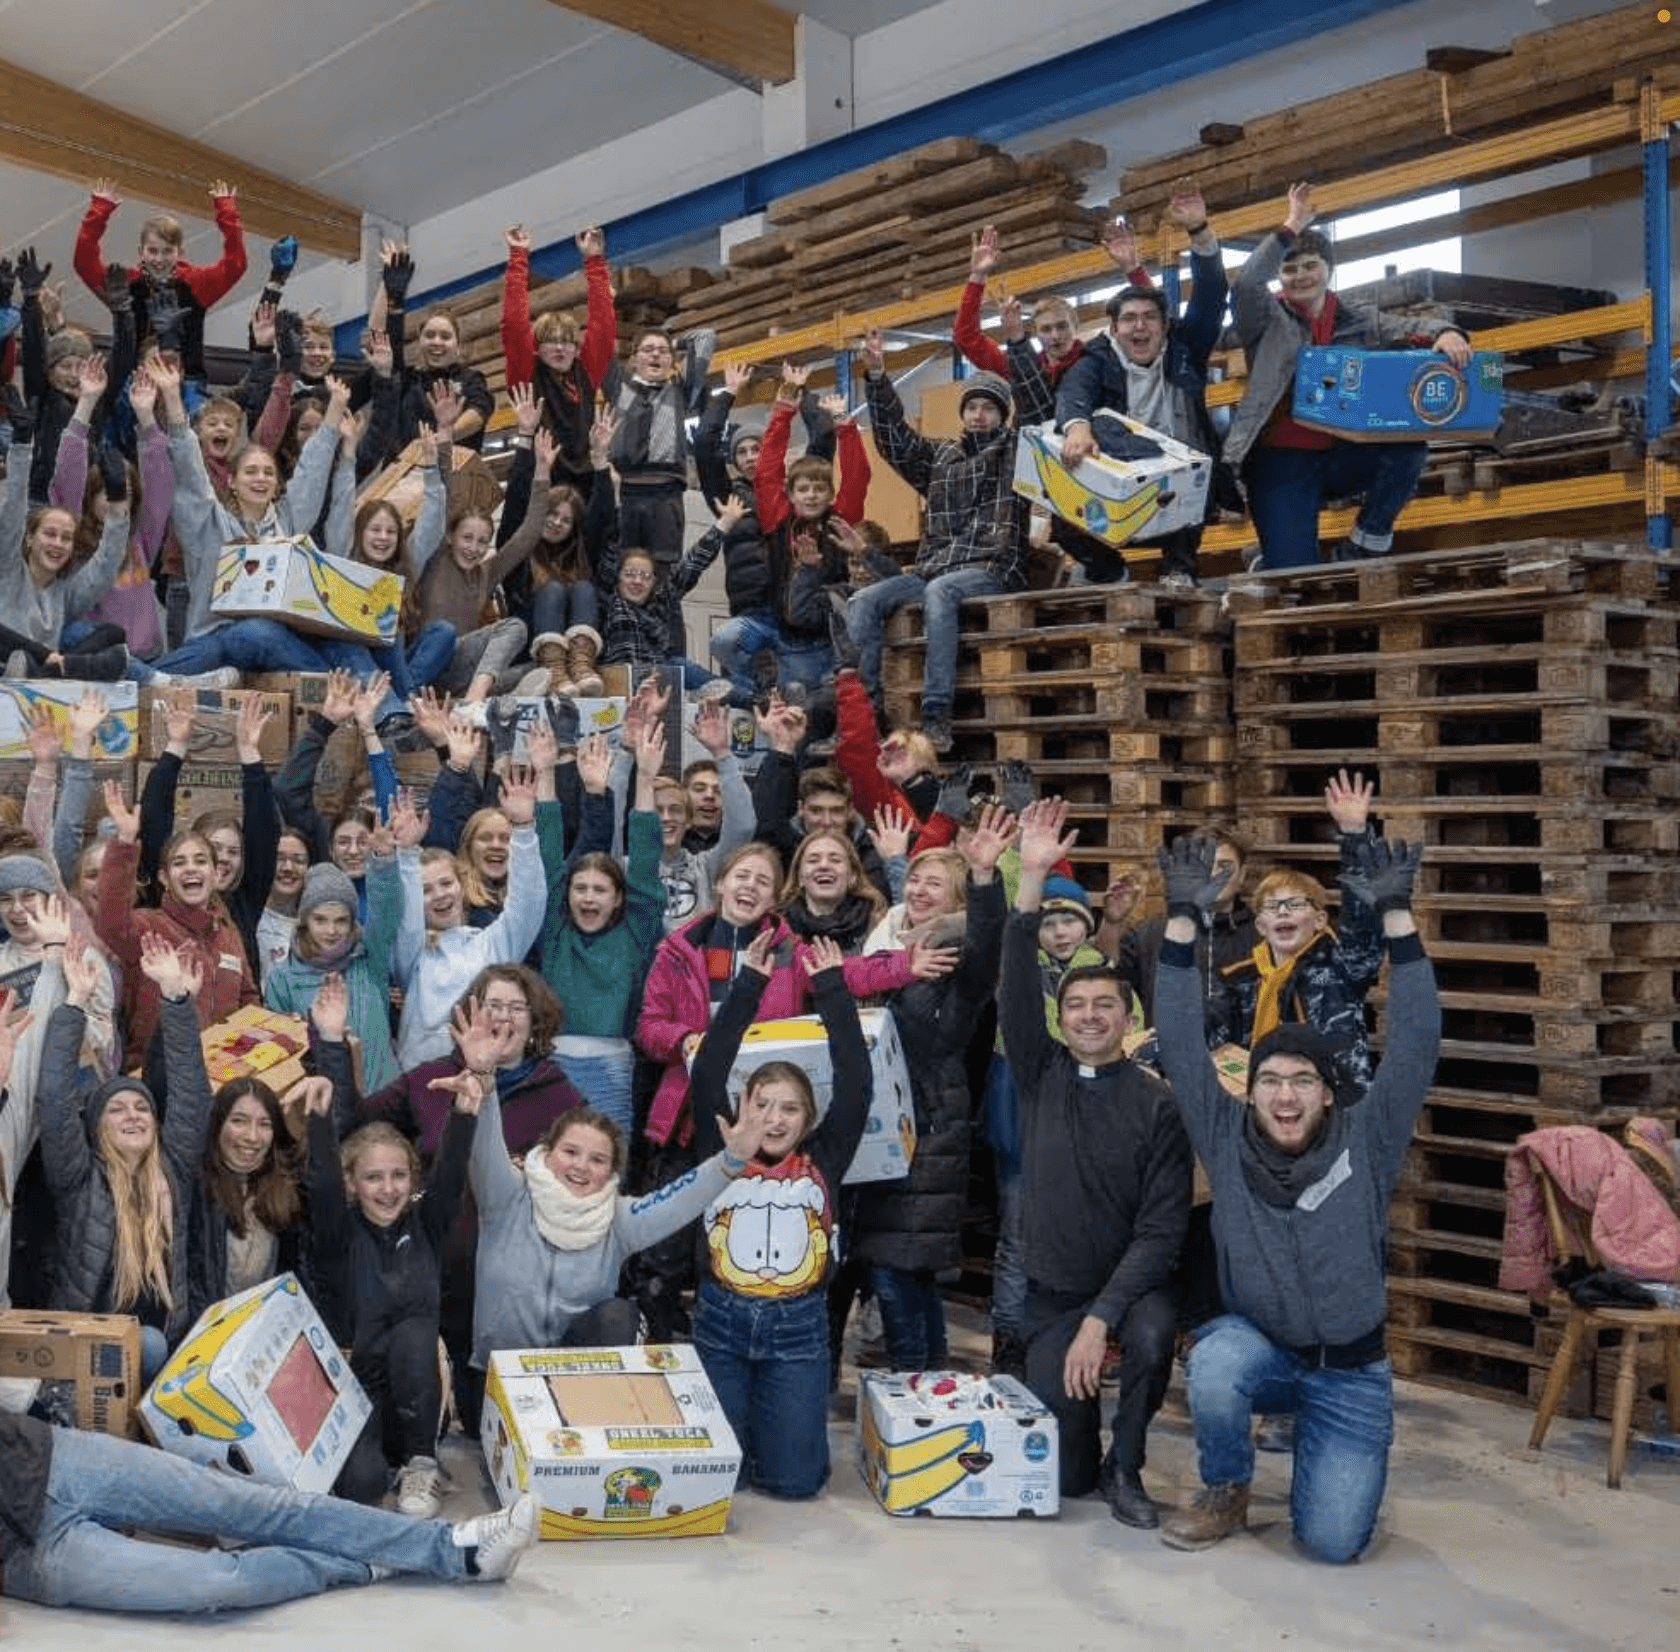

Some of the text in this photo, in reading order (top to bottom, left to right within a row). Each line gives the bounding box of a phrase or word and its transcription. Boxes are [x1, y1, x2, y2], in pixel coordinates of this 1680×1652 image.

[1425, 381, 1447, 397] BE
[533, 1463, 738, 1476] PREMIUM BANANAS
